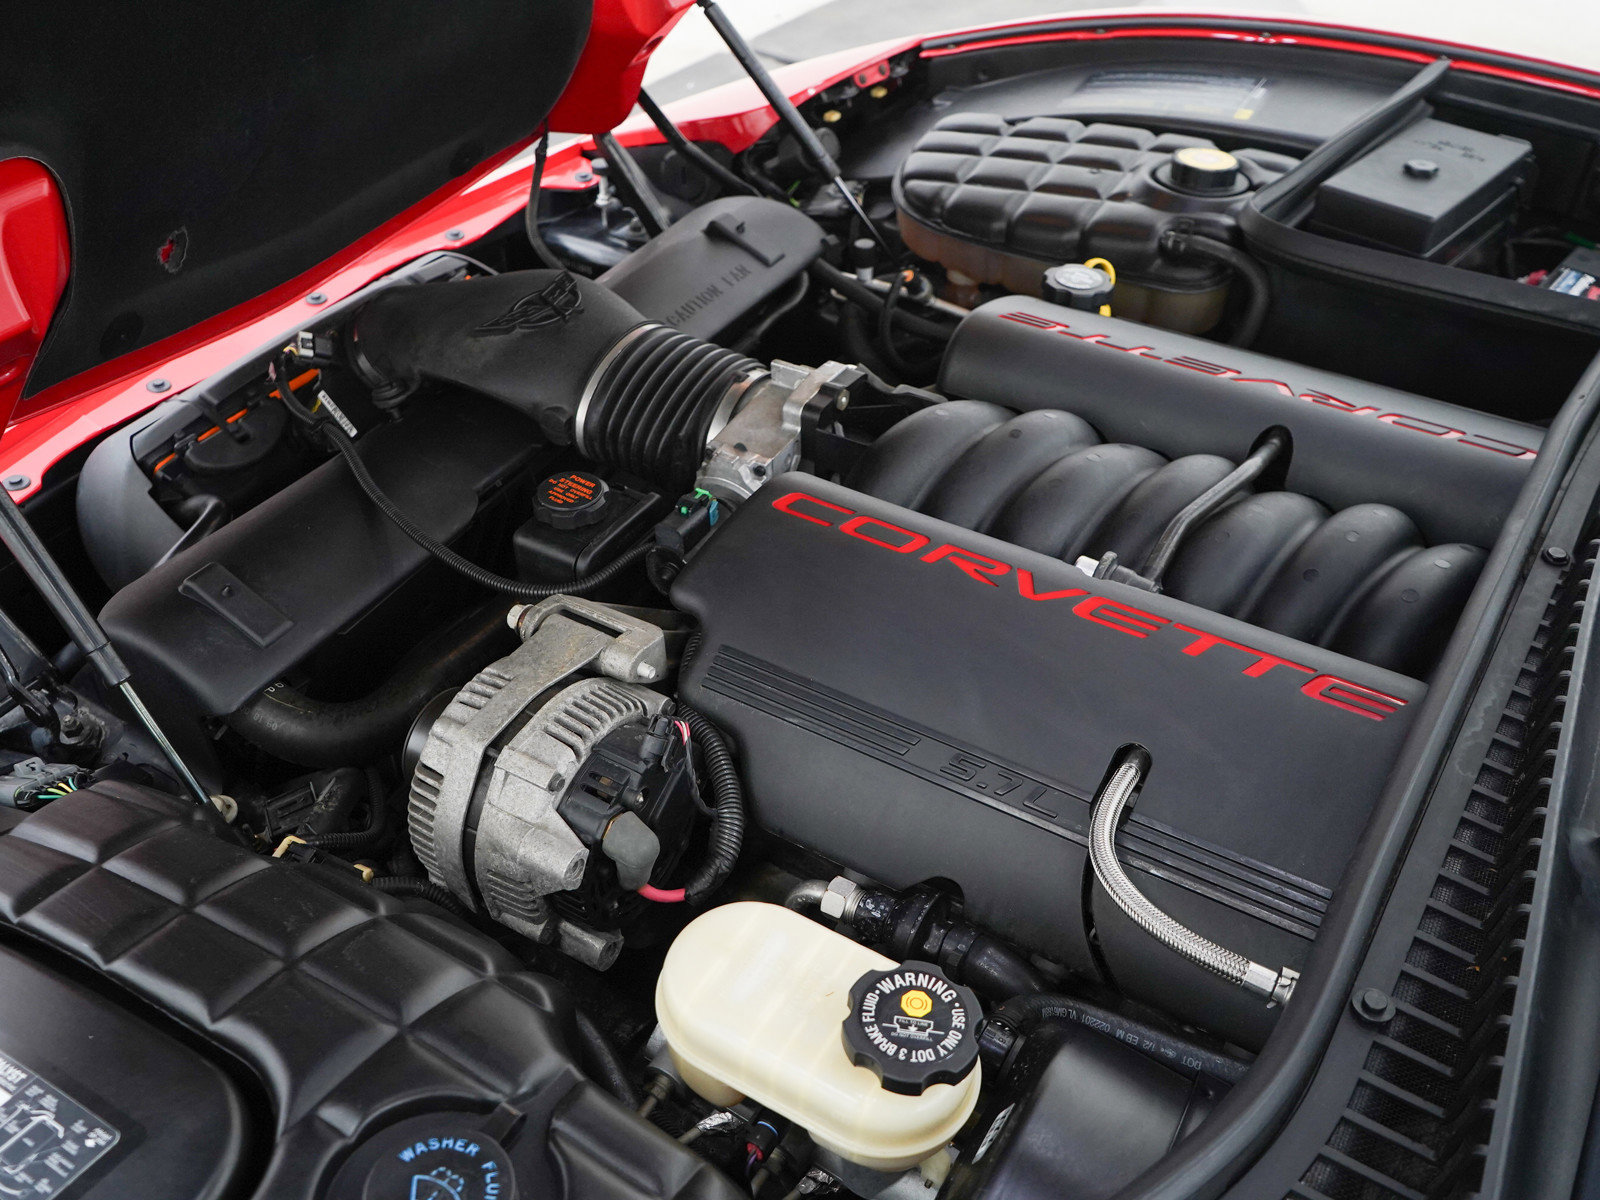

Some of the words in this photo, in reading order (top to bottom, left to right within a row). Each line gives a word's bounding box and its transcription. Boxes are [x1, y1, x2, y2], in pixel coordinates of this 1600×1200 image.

[666, 284, 723, 326] CAUTION
[999, 311, 1537, 459] CORVETTE
[560, 478, 593, 495] STEERING
[570, 474, 596, 488] POWER
[548, 490, 575, 503] APPROVED
[548, 496, 564, 504] FLUID
[772, 492, 1408, 722] CORVETTE
[939, 752, 1059, 819] 5.7L
[876, 972, 957, 1003] WARNING
[861, 992, 880, 1023] FLUID
[951, 1008, 966, 1030] USE
[864, 1023, 898, 1056] BRAKE
[937, 1029, 963, 1057] ONLY
[898, 1047, 908, 1060] 3
[910, 1048, 936, 1063] DOT
[398, 1137, 481, 1162] WASHER
